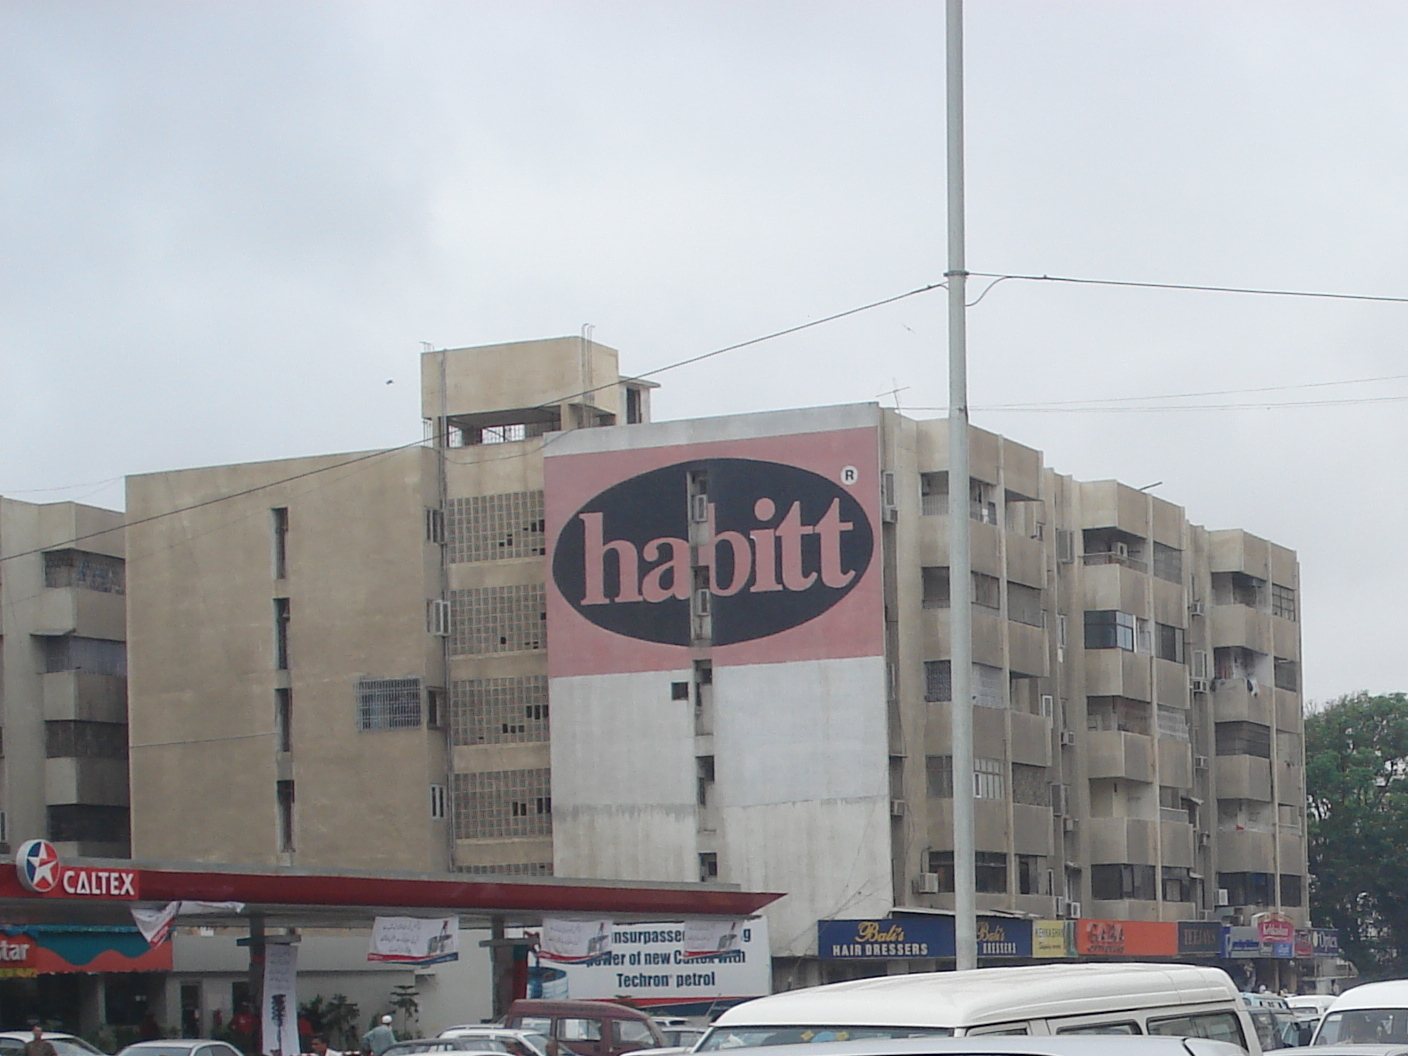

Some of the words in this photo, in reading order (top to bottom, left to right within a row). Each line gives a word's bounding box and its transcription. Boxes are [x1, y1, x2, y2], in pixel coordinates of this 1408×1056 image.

[578, 496, 857, 607] habitt
[63, 870, 135, 896] CALTEX
[611, 930, 685, 945] nsurpasse
[854, 921, 905, 943] Bali's
[0, 940, 30, 961] tar
[628, 950, 641, 965] of
[644, 953, 670, 965] new
[833, 944, 862, 956] HAIR
[865, 943, 928, 956] DRESSERS
[676, 971, 716, 988] petrol
